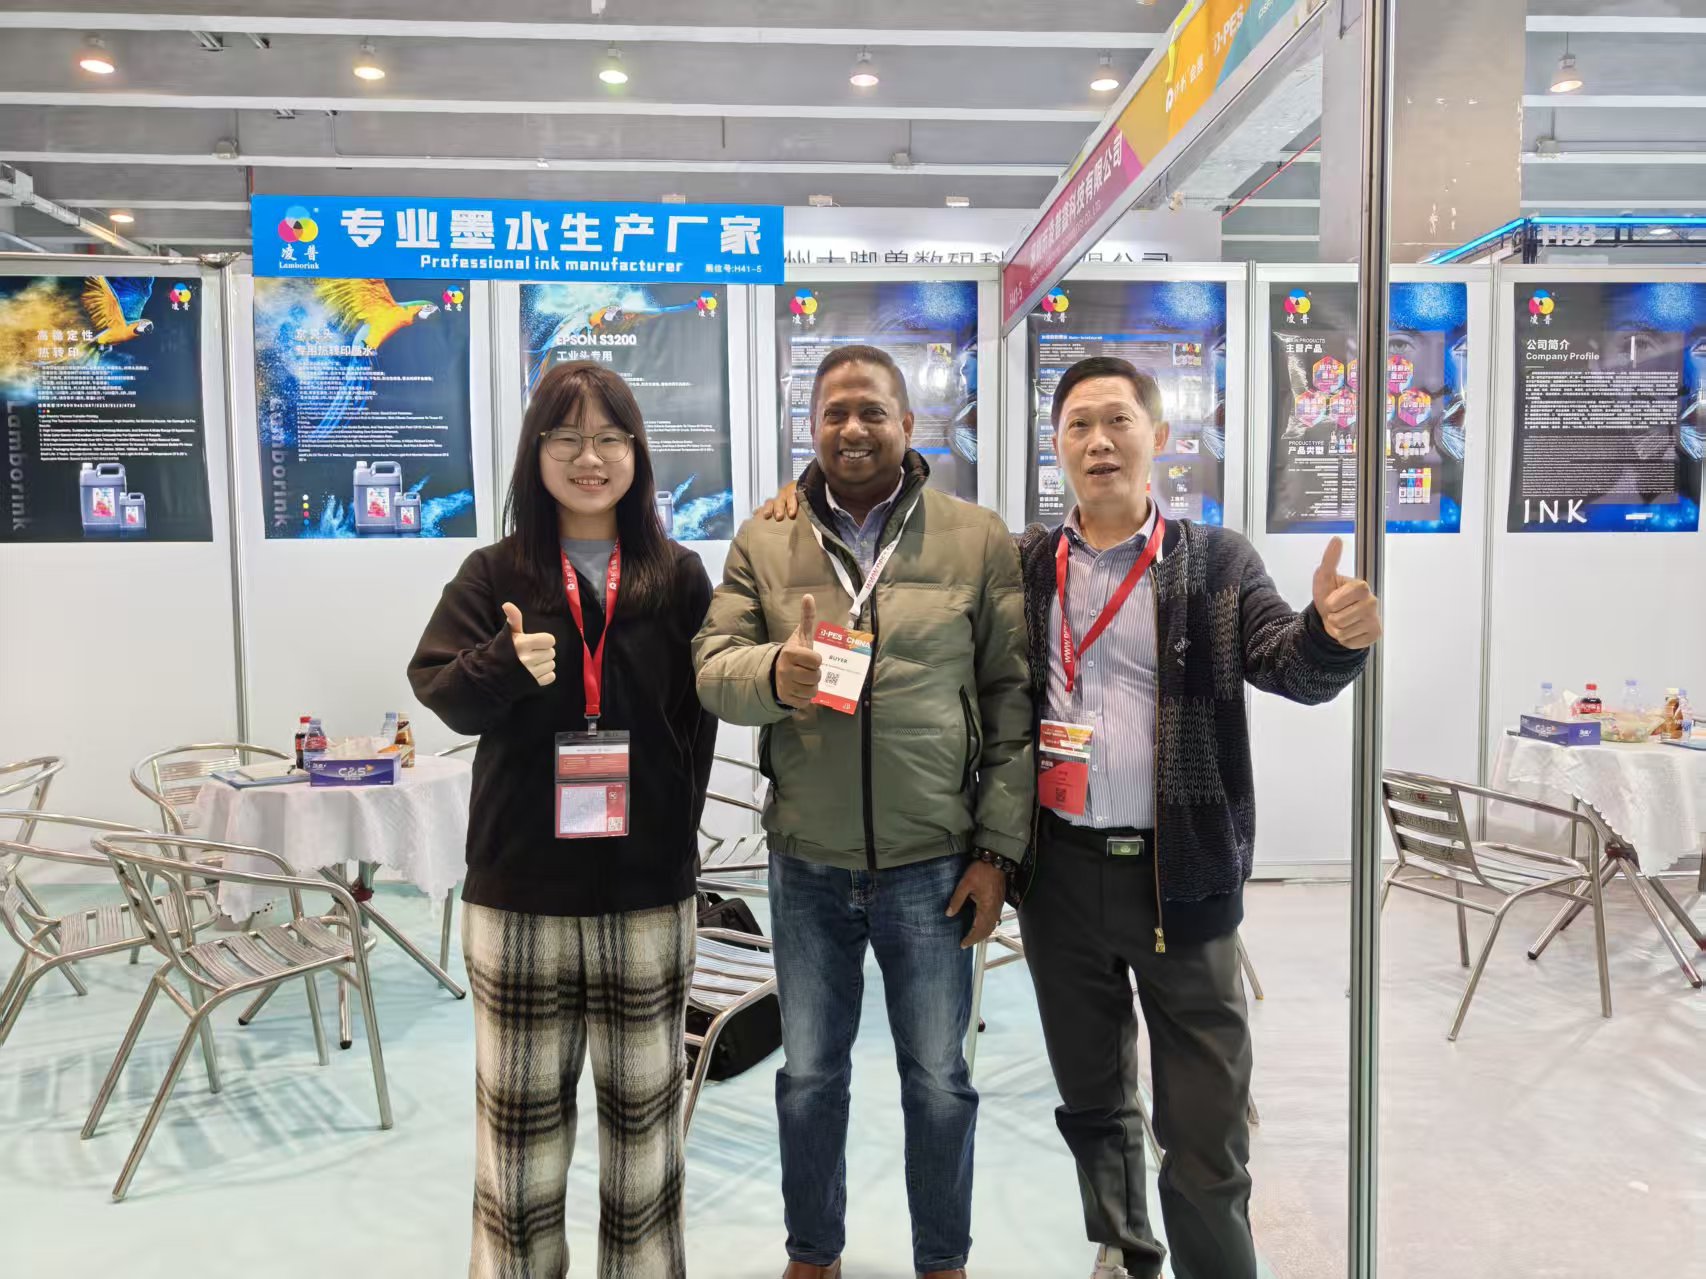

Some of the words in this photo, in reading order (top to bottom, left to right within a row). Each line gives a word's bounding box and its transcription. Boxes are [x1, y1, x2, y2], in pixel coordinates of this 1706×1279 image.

[340, 208, 762, 255] 专业墨水生产厂家
[279, 260, 320, 269] Lamborink
[420, 255, 529, 270] Professional
[535, 256, 560, 271] ink
[565, 257, 684, 273] manufacturer
[556, 334, 597, 346] EPSON
[600, 334, 637, 346] S3200
[1526, 339, 1570, 350] 公司简介
[1286, 344, 1322, 353] 主营产品
[556, 350, 613, 362] 工业头专用
[1526, 352, 1568, 361] Company
[1569, 352, 1600, 360] Profile
[1524, 498, 1588, 523] INK
[846, 636, 871, 649] CHINA
[829, 655, 848, 663] BUYER
[338, 767, 366, 777] C&S
